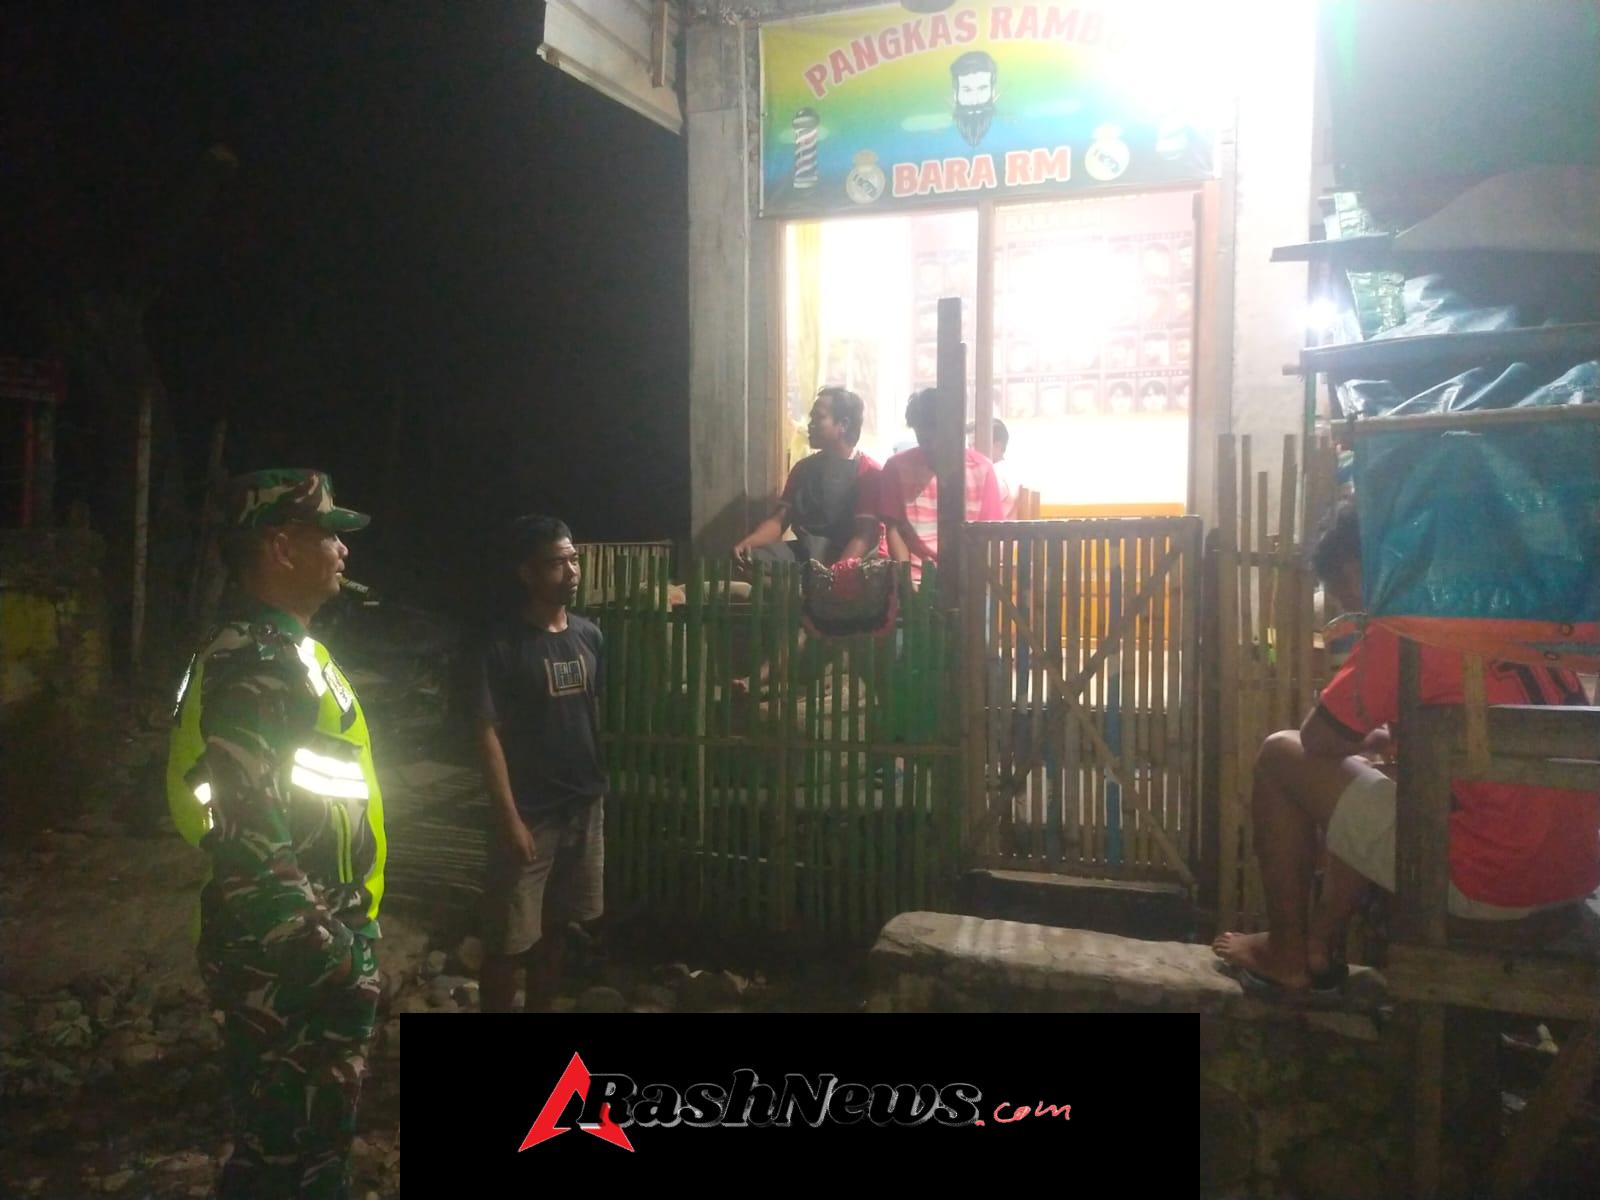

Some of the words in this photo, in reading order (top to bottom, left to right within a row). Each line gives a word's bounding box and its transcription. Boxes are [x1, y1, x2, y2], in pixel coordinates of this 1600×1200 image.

[804, 9, 978, 98] PANGKAS
[989, 5, 1126, 52] RAMB
[893, 154, 997, 196] BARA
[1005, 145, 1071, 186] RM
